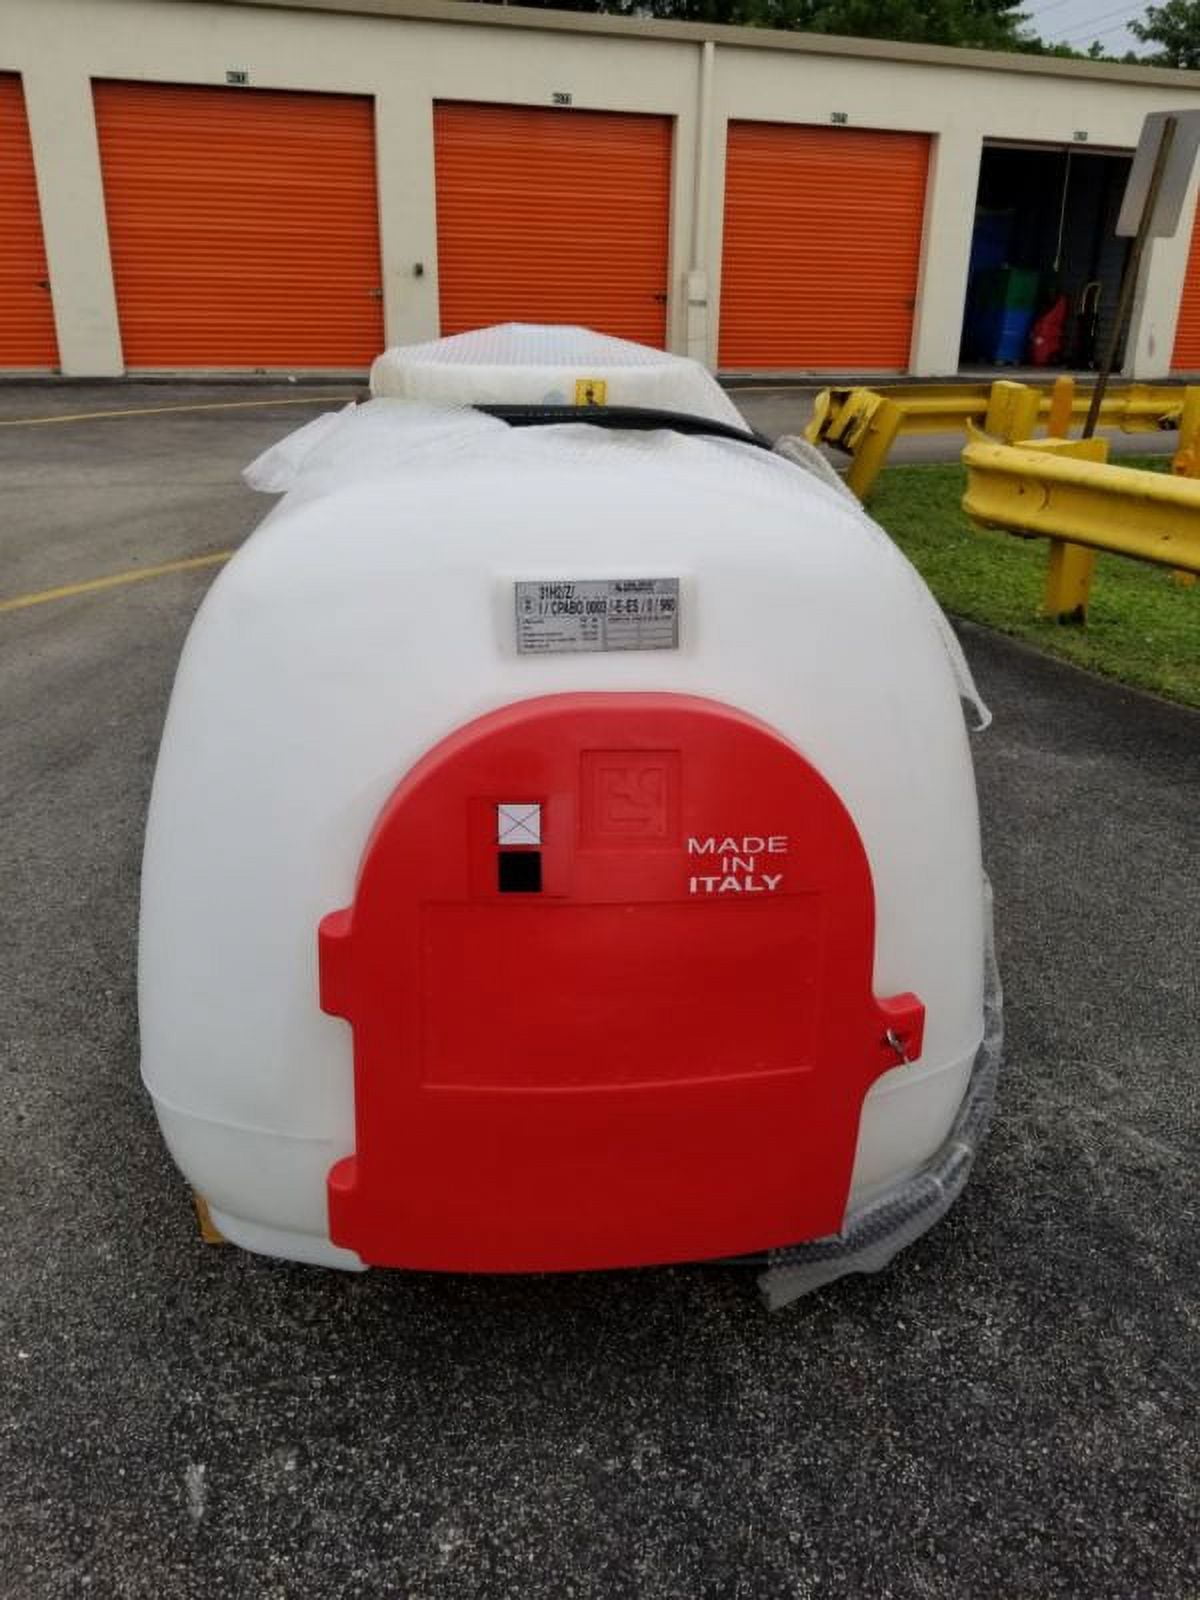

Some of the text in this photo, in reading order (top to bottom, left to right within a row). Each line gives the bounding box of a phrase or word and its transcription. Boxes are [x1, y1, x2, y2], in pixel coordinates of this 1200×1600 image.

[688, 836, 788, 854] MADE
[722, 856, 754, 873] IN
[690, 874, 783, 893] ITALY
